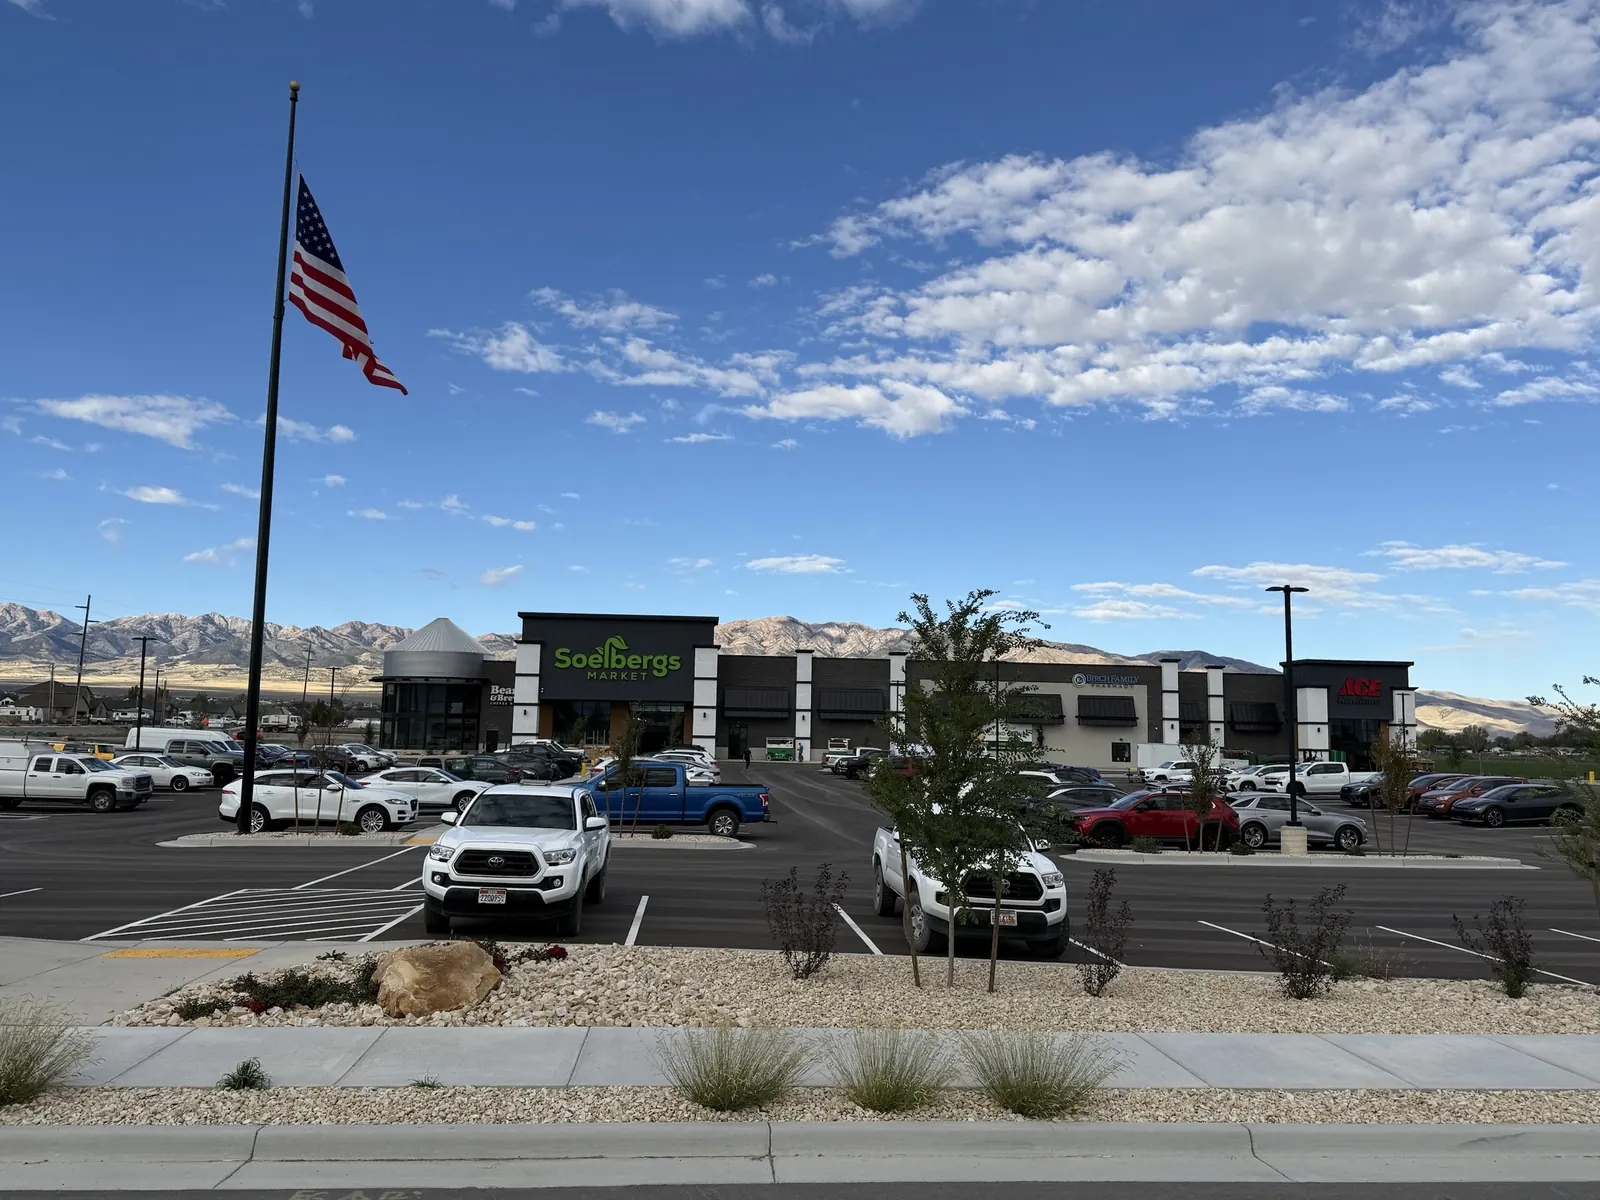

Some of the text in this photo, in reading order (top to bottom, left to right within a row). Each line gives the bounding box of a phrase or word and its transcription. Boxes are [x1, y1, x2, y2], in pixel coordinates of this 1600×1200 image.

[554, 635, 681, 677] Soelbergs
[587, 671, 648, 681] MARKET
[1086, 674, 1140, 683] BIRCH FAMILY
[1338, 676, 1383, 697] ACE
